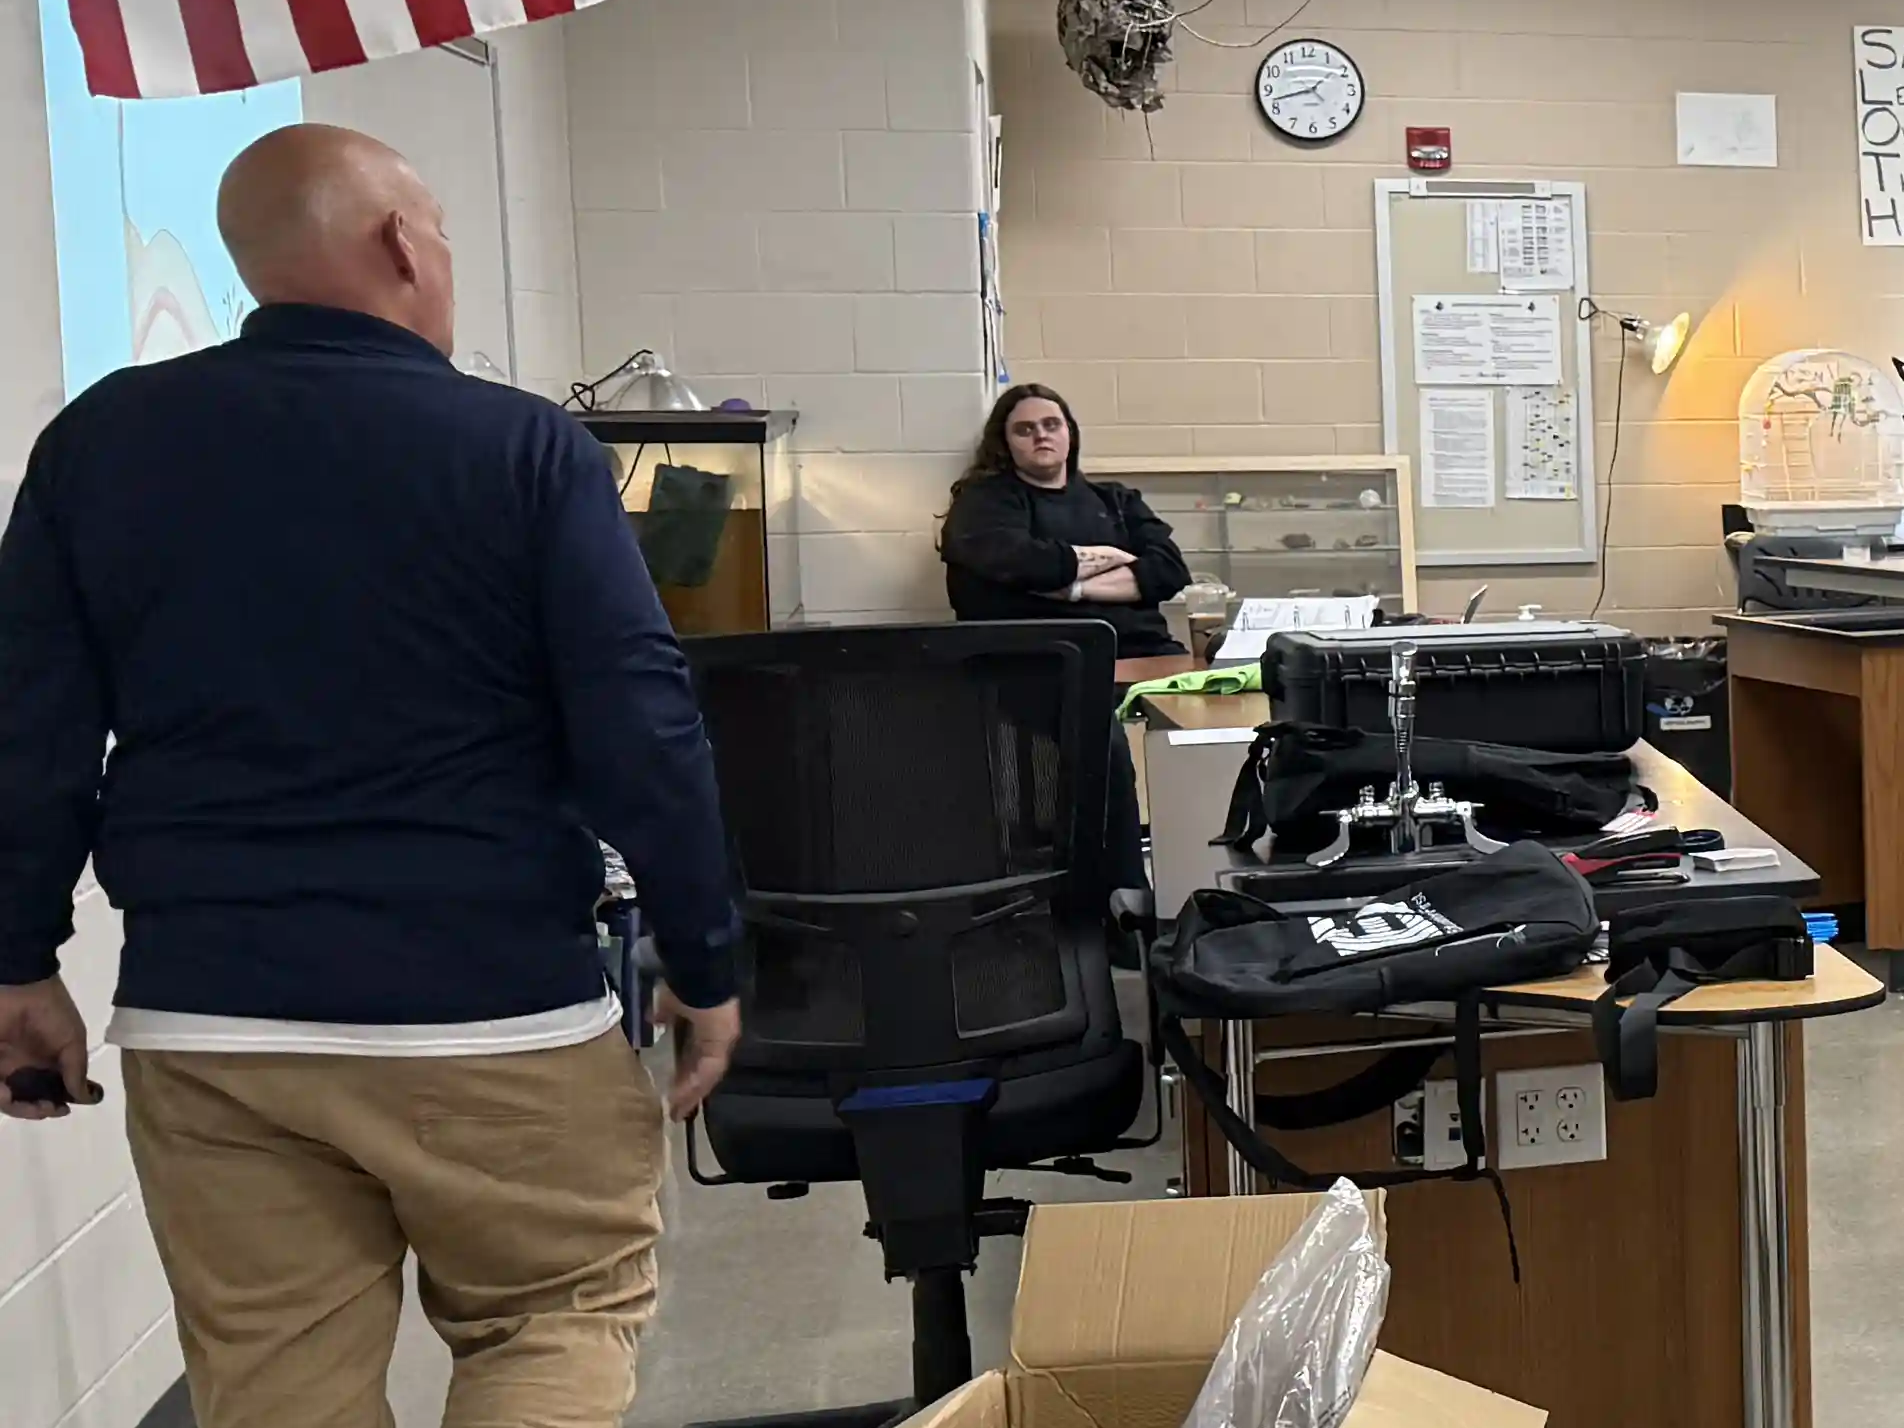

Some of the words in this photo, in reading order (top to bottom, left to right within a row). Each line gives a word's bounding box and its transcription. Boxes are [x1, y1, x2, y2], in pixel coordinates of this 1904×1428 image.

[1283, 51, 1294, 65] 11
[1301, 46, 1316, 59] 12
[1324, 51, 1330, 65] 1
[1266, 64, 1281, 79] 10
[1339, 64, 1349, 78] 2
[1263, 83, 1273, 97] 9
[1346, 83, 1356, 97] 3
[1271, 101, 1281, 115] 8
[1341, 102, 1350, 116] 4
[1288, 117, 1298, 130] 7
[1308, 121, 1318, 134] 6
[1328, 116, 1337, 130] 5
